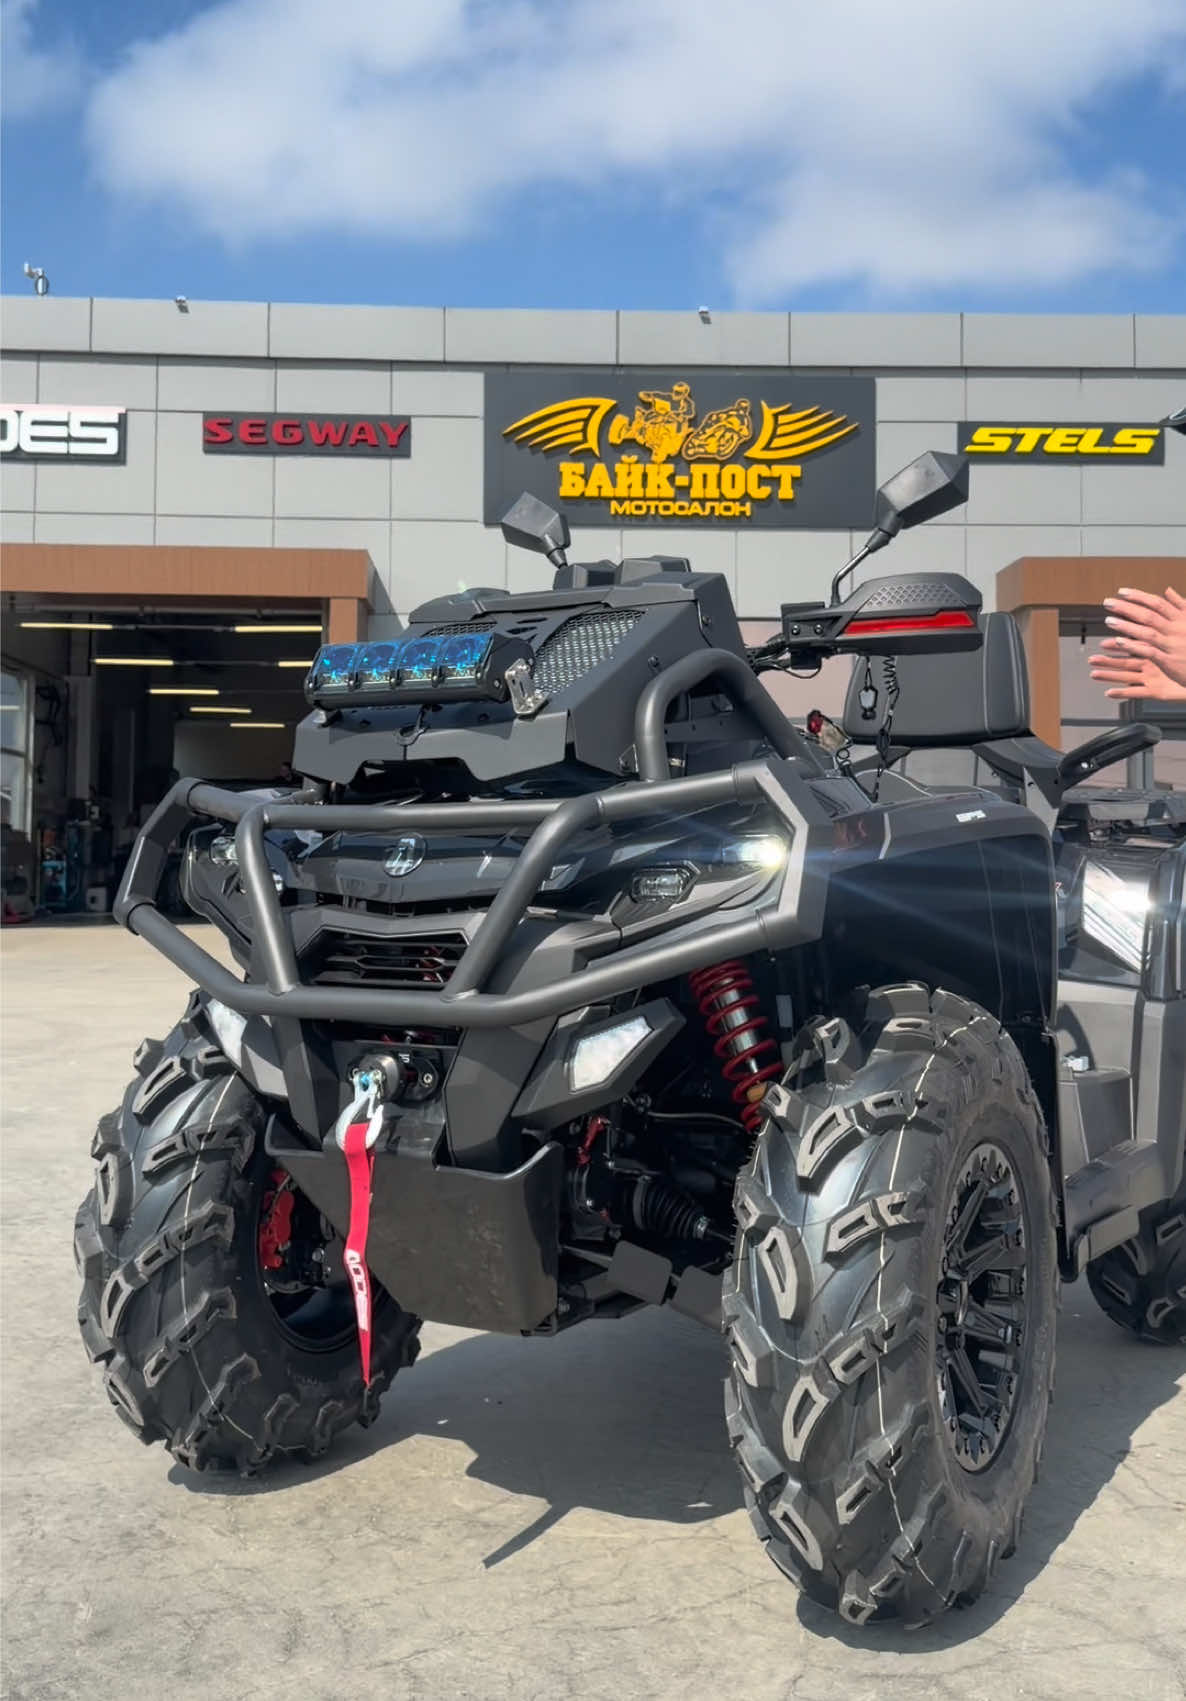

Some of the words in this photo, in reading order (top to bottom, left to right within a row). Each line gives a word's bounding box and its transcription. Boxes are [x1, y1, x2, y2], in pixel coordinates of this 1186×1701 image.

[203, 417, 409, 449] SEGWAY
[963, 426, 1161, 455] STELS
[558, 454, 803, 501] БАЙК-ПОСТ
[609, 500, 752, 518] МОТОСАЛОН
